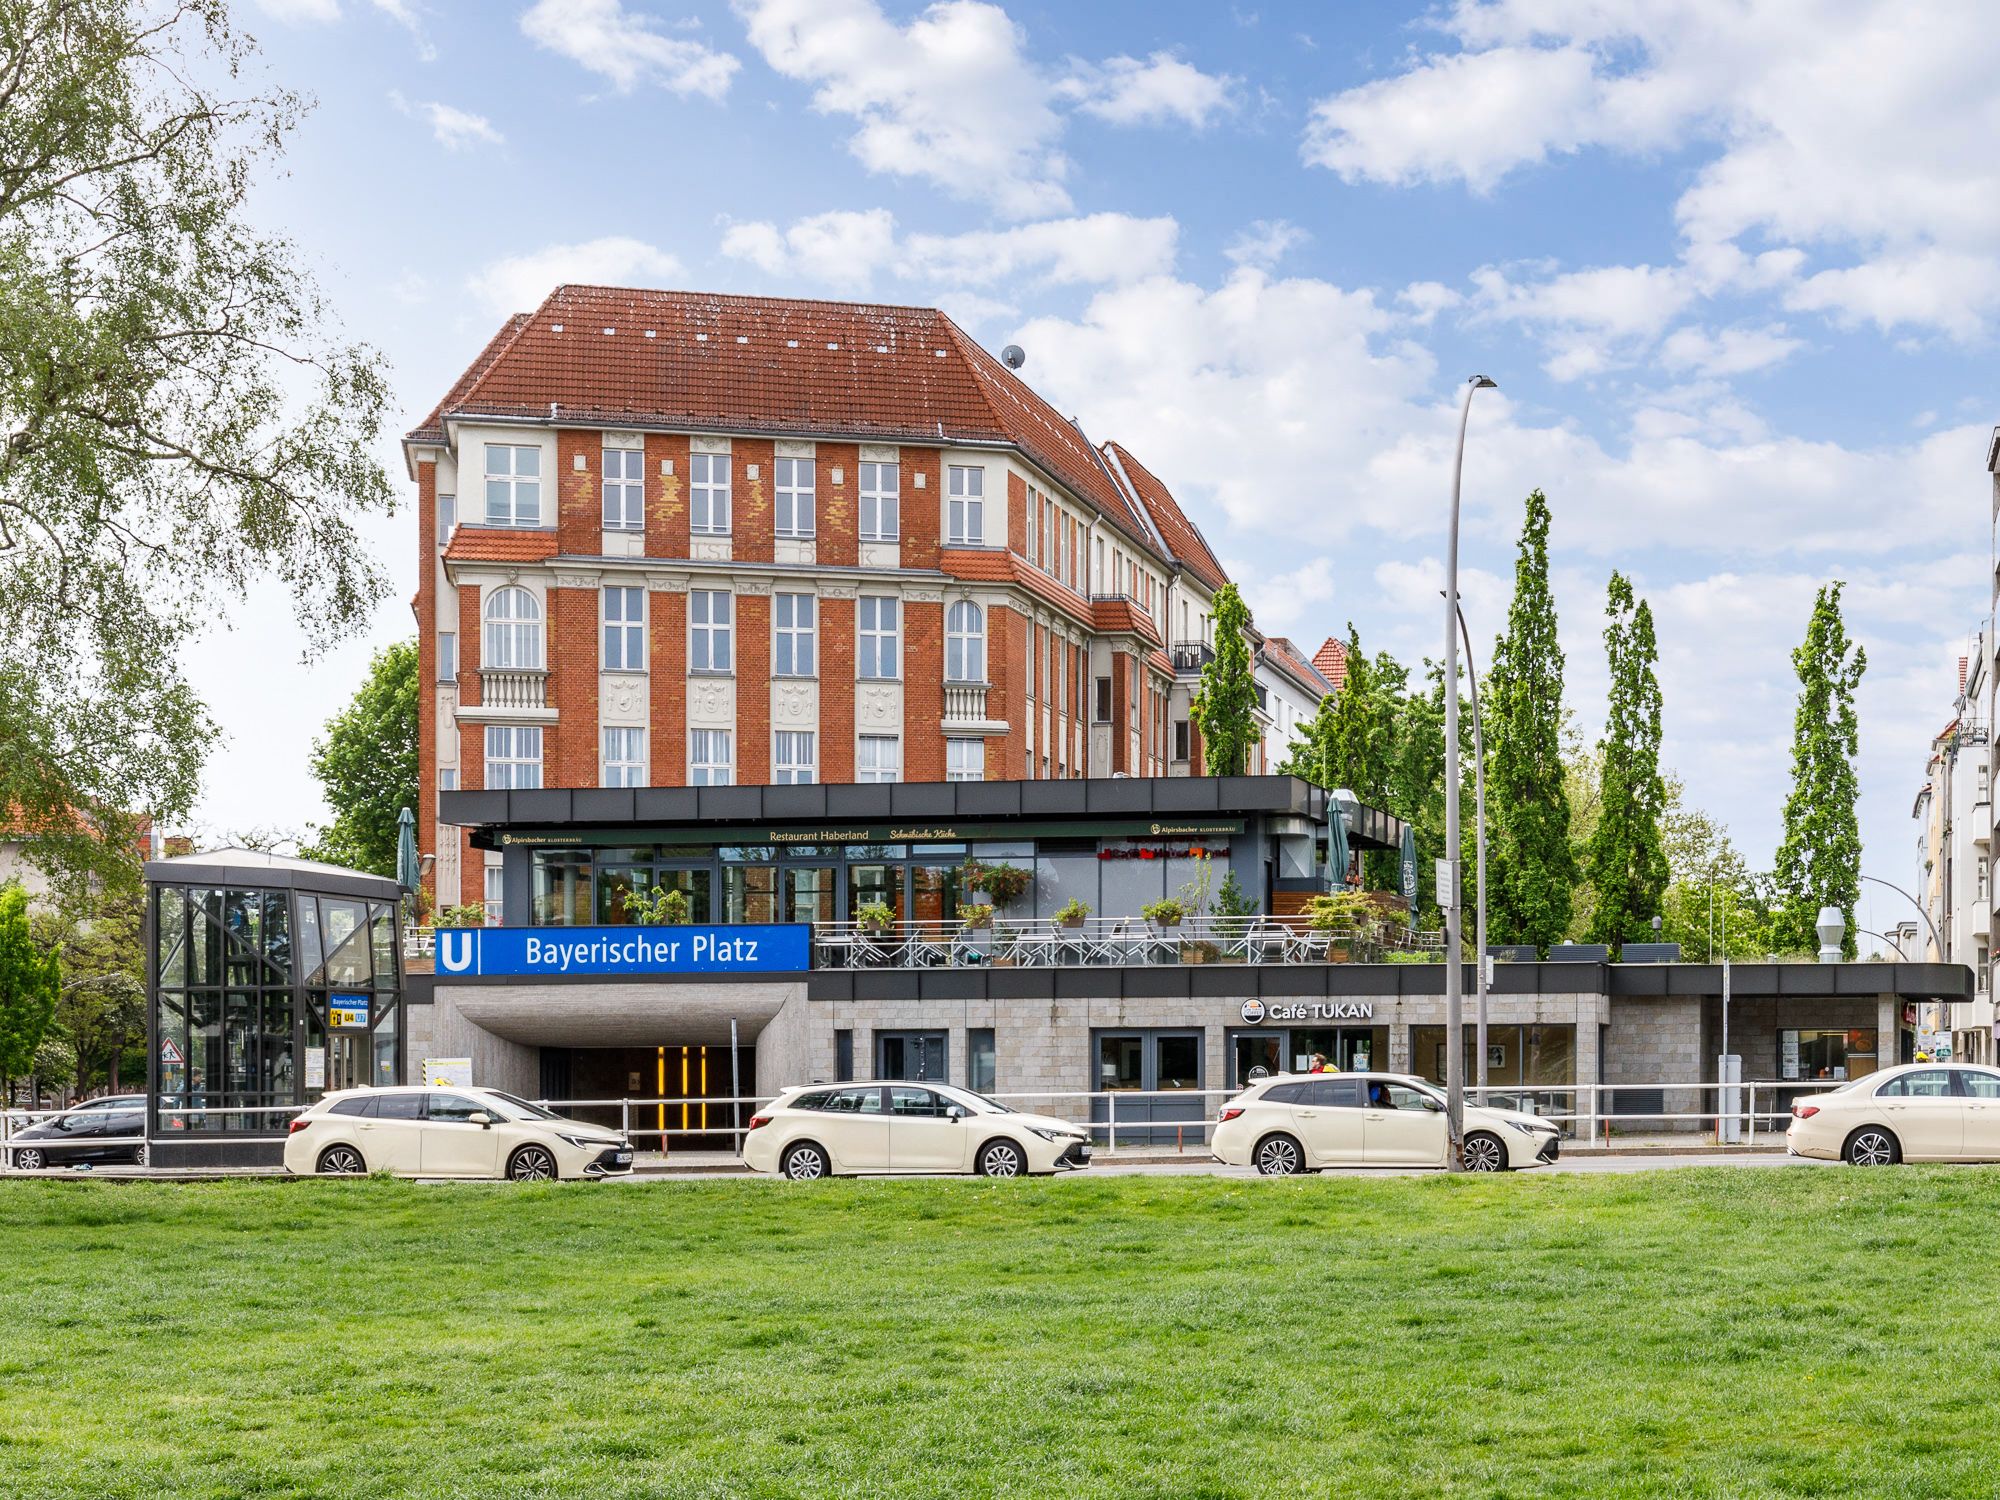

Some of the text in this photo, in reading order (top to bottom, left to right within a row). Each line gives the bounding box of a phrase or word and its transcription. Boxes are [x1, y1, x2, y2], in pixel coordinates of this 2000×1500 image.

[890, 829, 957, 839] Schwäbische Küche
[1162, 826, 1197, 834] Alpirsbacher
[770, 830, 869, 841] Restaurant Haberland
[442, 932, 472, 971] U
[526, 933, 758, 971] Bayerischer Platz
[333, 998, 357, 1006] Bayerischer
[1269, 1002, 1373, 1020] Café TUKAN
[344, 1013, 354, 1022] U4
[356, 1013, 366, 1022] U7
